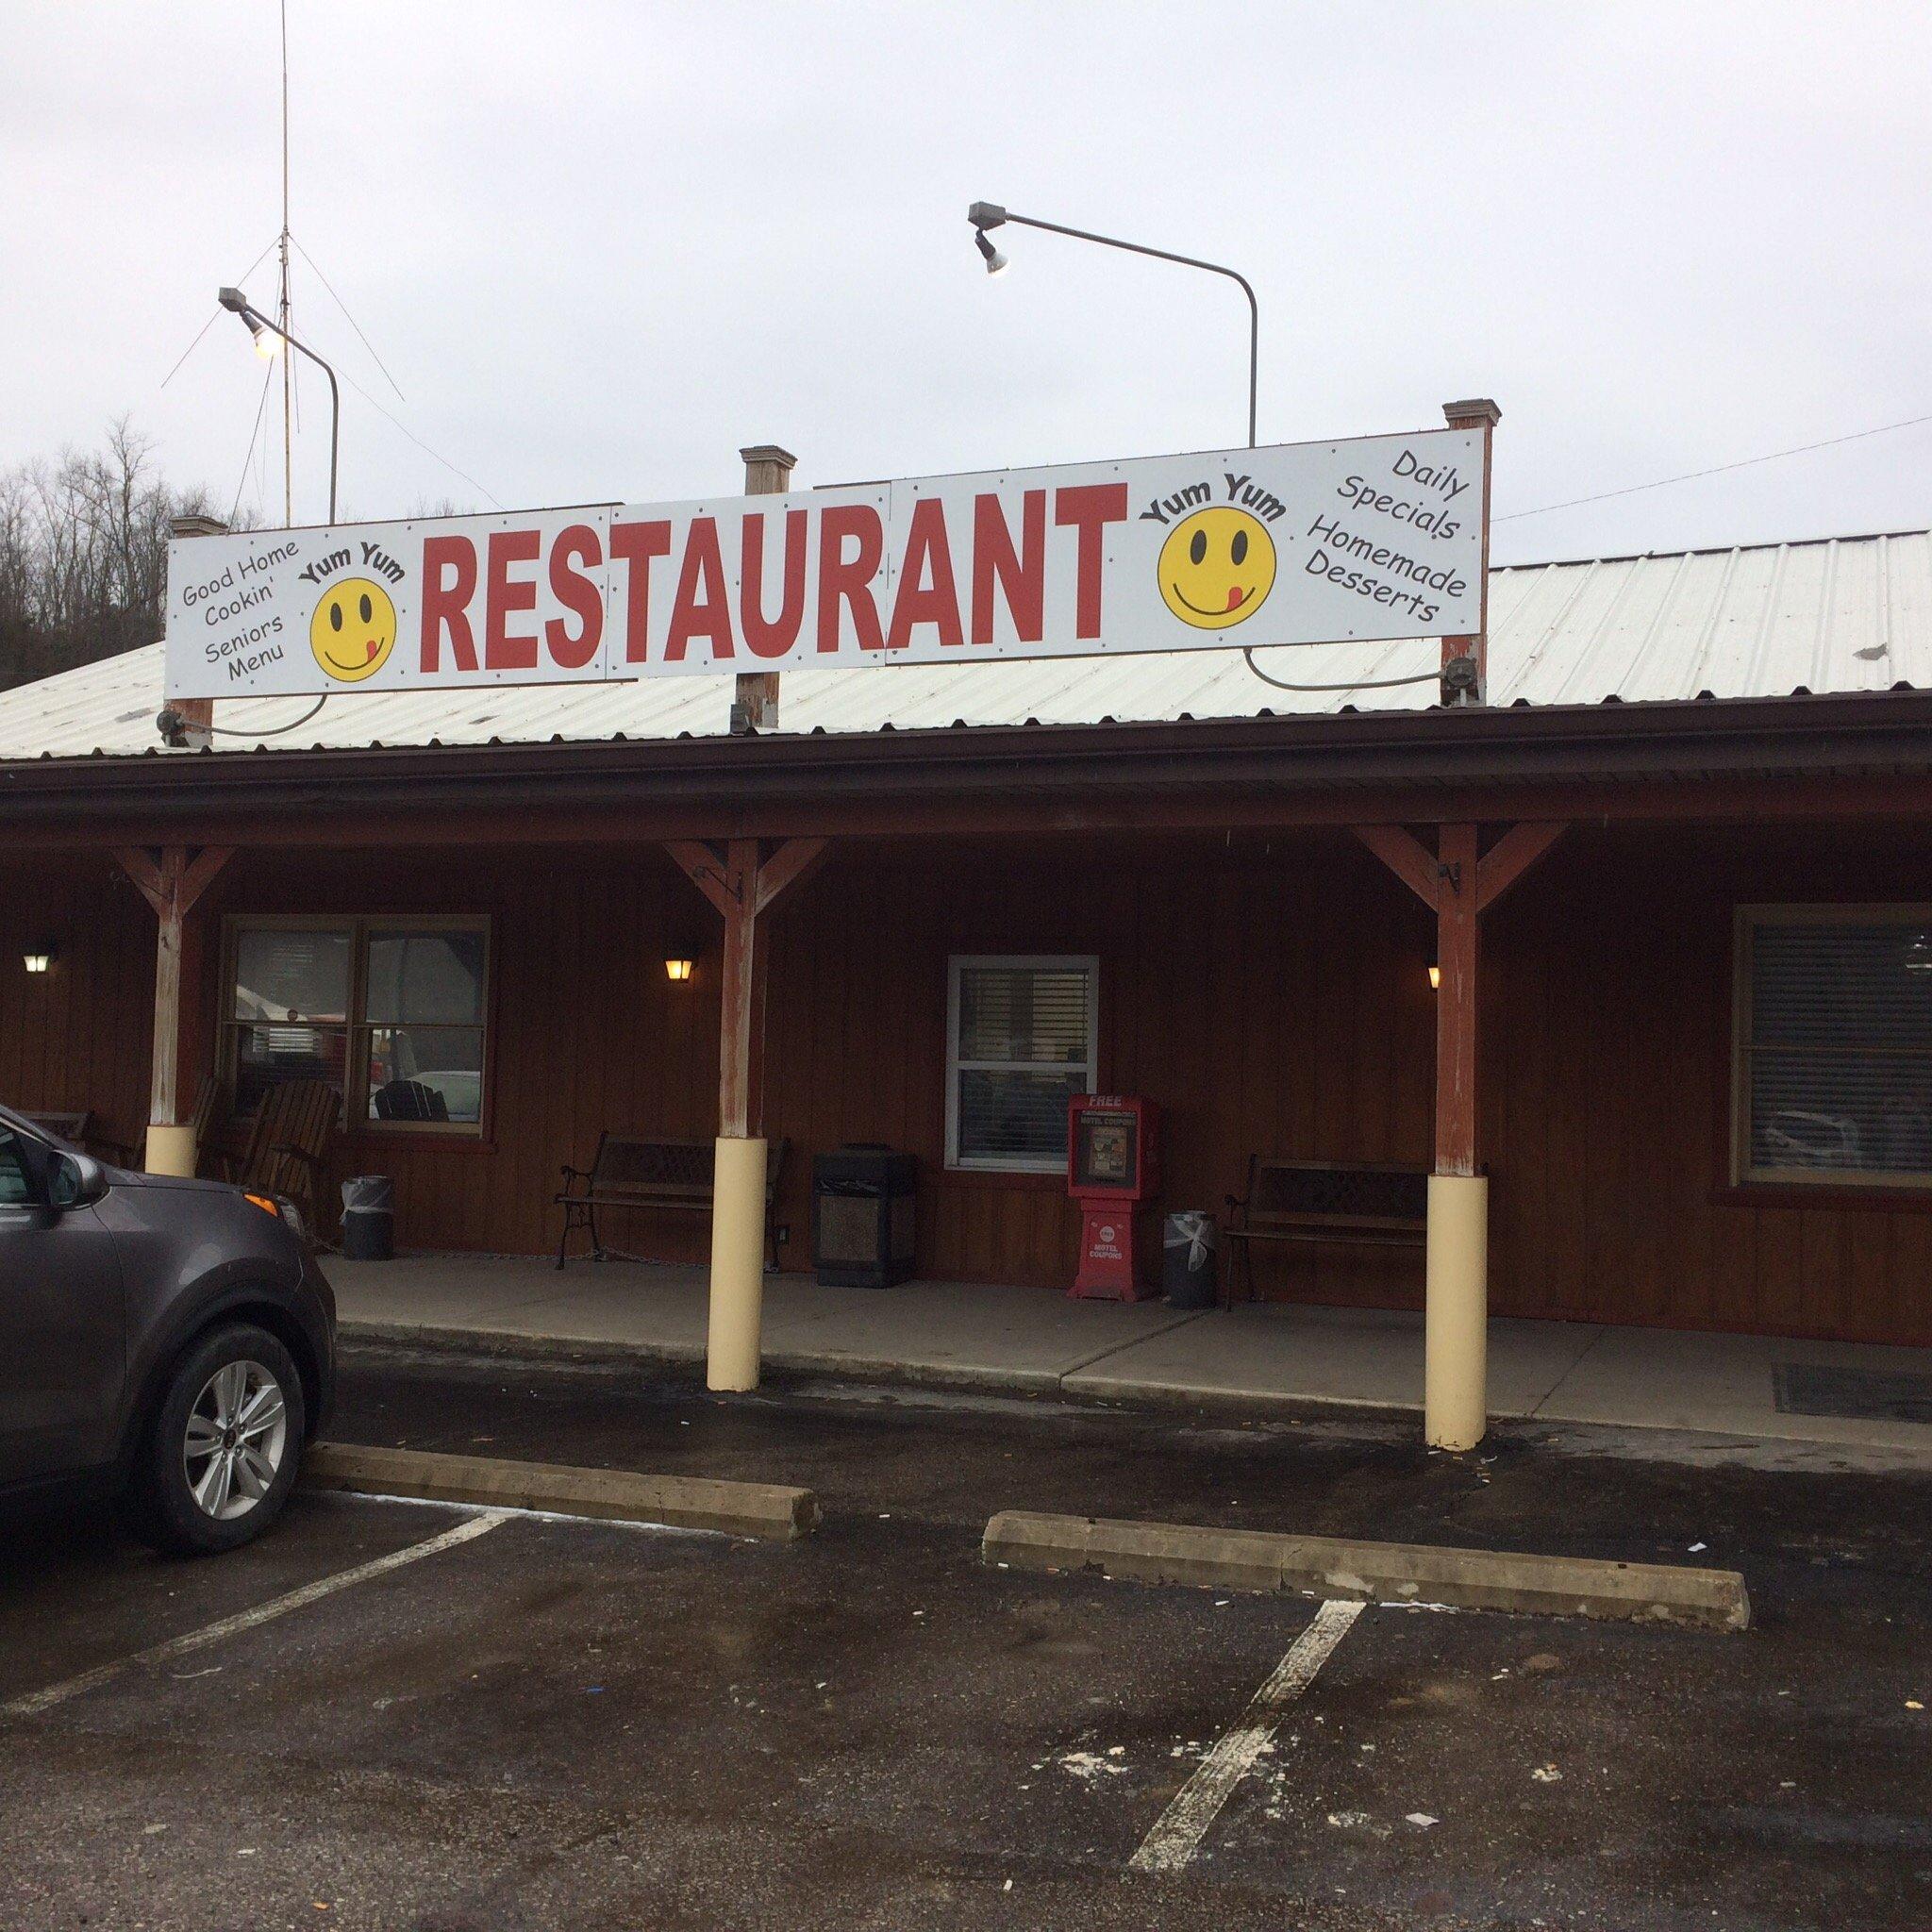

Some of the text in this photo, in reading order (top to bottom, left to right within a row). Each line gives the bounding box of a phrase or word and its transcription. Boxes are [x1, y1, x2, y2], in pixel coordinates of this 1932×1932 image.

[1139, 473, 1287, 525] Yum Yum
[1391, 449, 1470, 502] Daily
[1337, 475, 1460, 539] Specials
[183, 541, 299, 607] Good Home
[298, 541, 406, 586] Yum Yum
[420, 482, 1128, 674] RESTAURANT
[1307, 514, 1467, 598] Homemade
[205, 575, 274, 626] Cookin'
[1305, 548, 1440, 622] Desserts
[205, 616, 283, 663] Seniors
[228, 644, 284, 681] Menu
[1089, 1095, 1123, 1107] FREE
